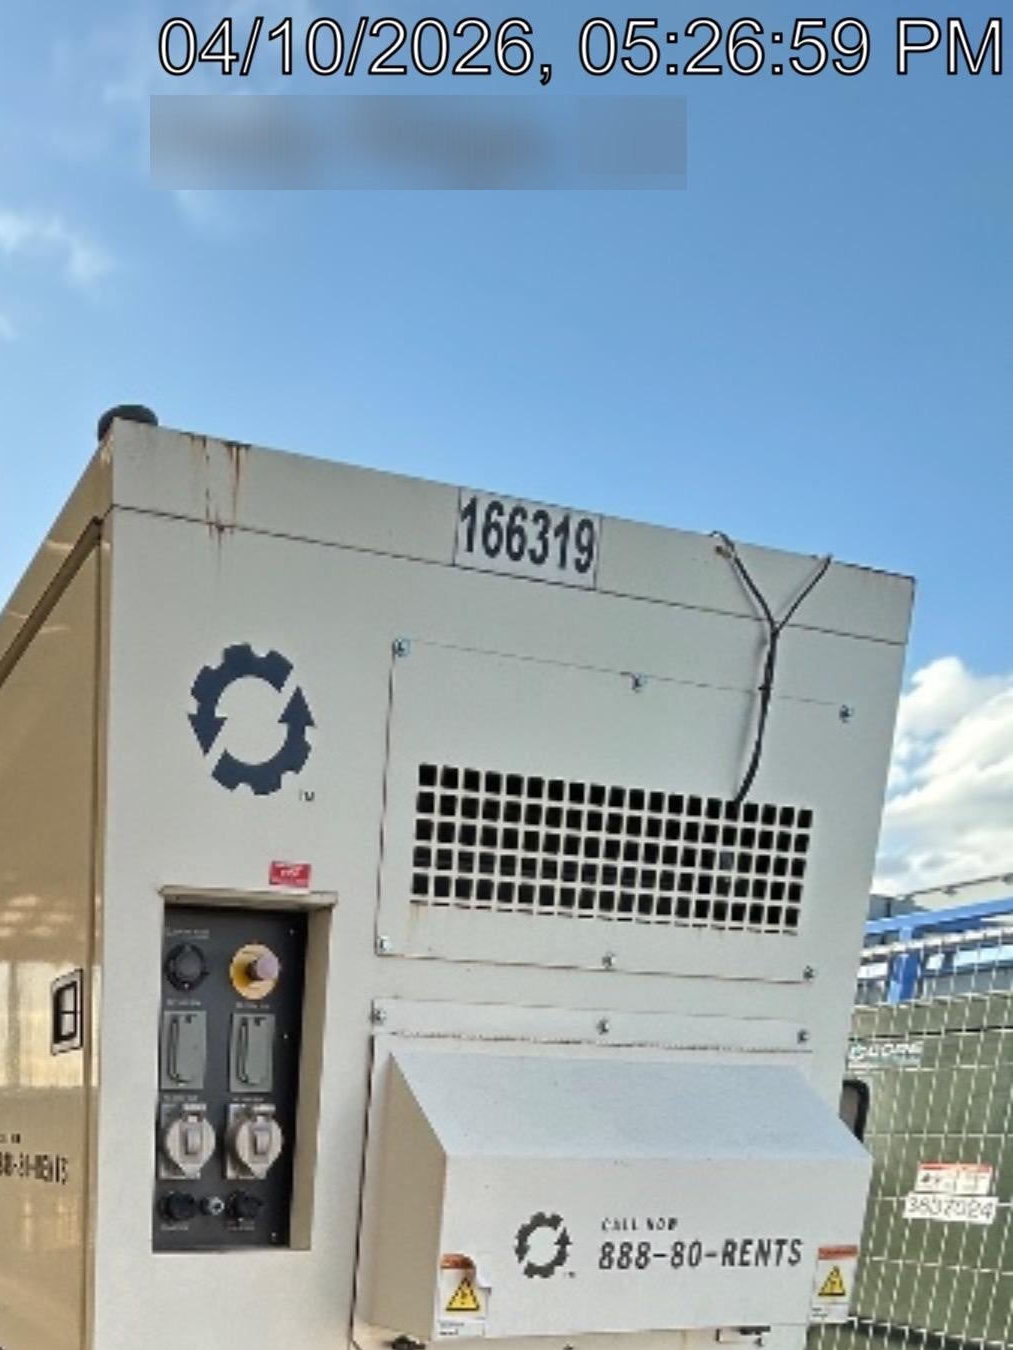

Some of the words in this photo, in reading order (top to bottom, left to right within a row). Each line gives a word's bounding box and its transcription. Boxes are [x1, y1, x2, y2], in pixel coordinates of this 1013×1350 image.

[460, 496, 595, 574] 166319
[600, 1216, 639, 1232] CALL
[646, 1216, 679, 1232] NOW
[597, 1238, 804, 1270] 888-80-RENTS
